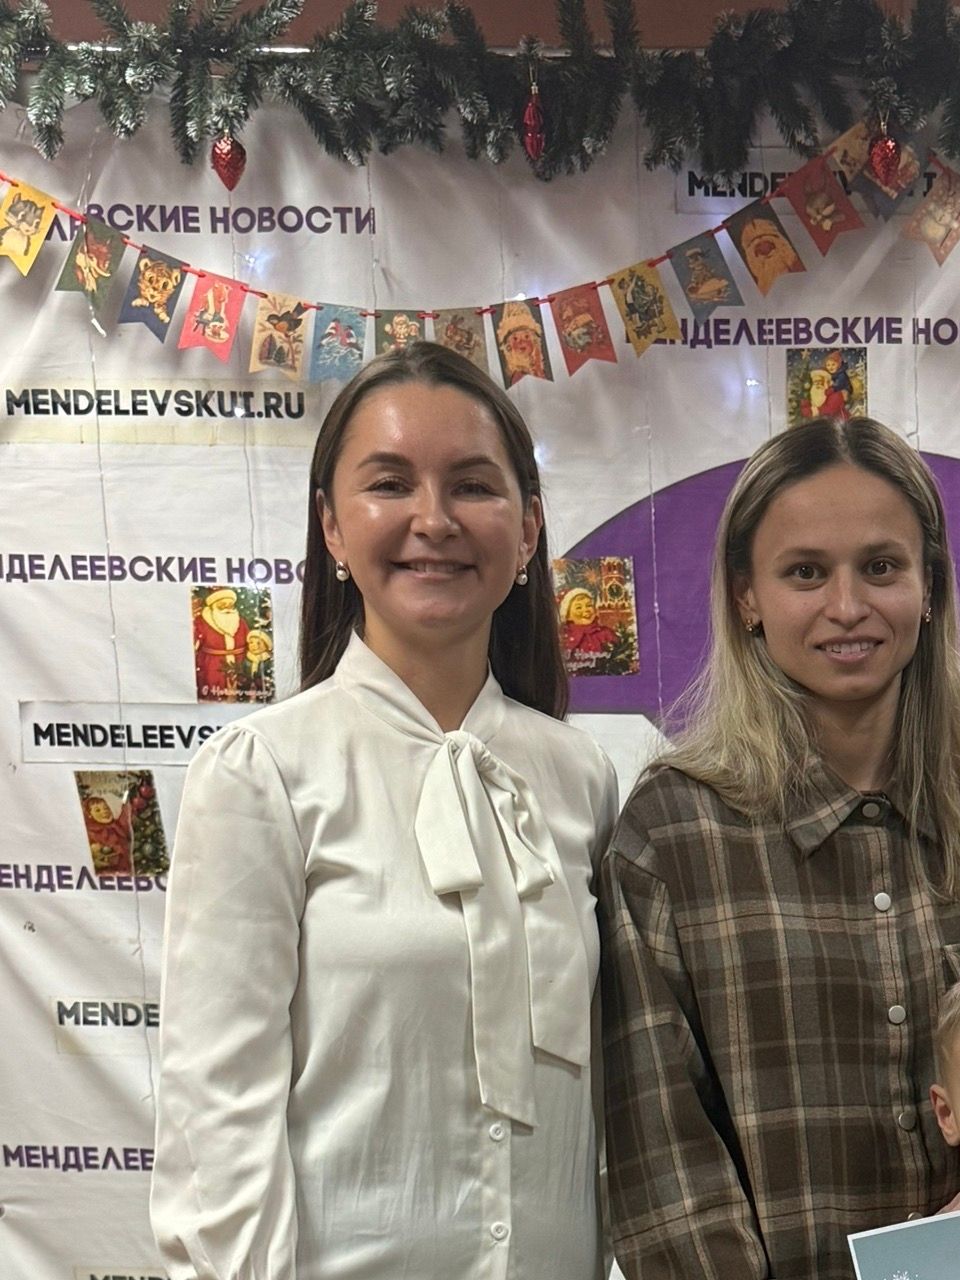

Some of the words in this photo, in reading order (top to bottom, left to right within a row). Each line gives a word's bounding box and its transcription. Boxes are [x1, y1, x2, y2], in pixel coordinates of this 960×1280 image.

[210, 205, 376, 236] НОВОСТИ
[33, 722, 222, 749] MENDELEEVS
[3, 1144, 154, 1172] МЕНДЕЛЕЕ
